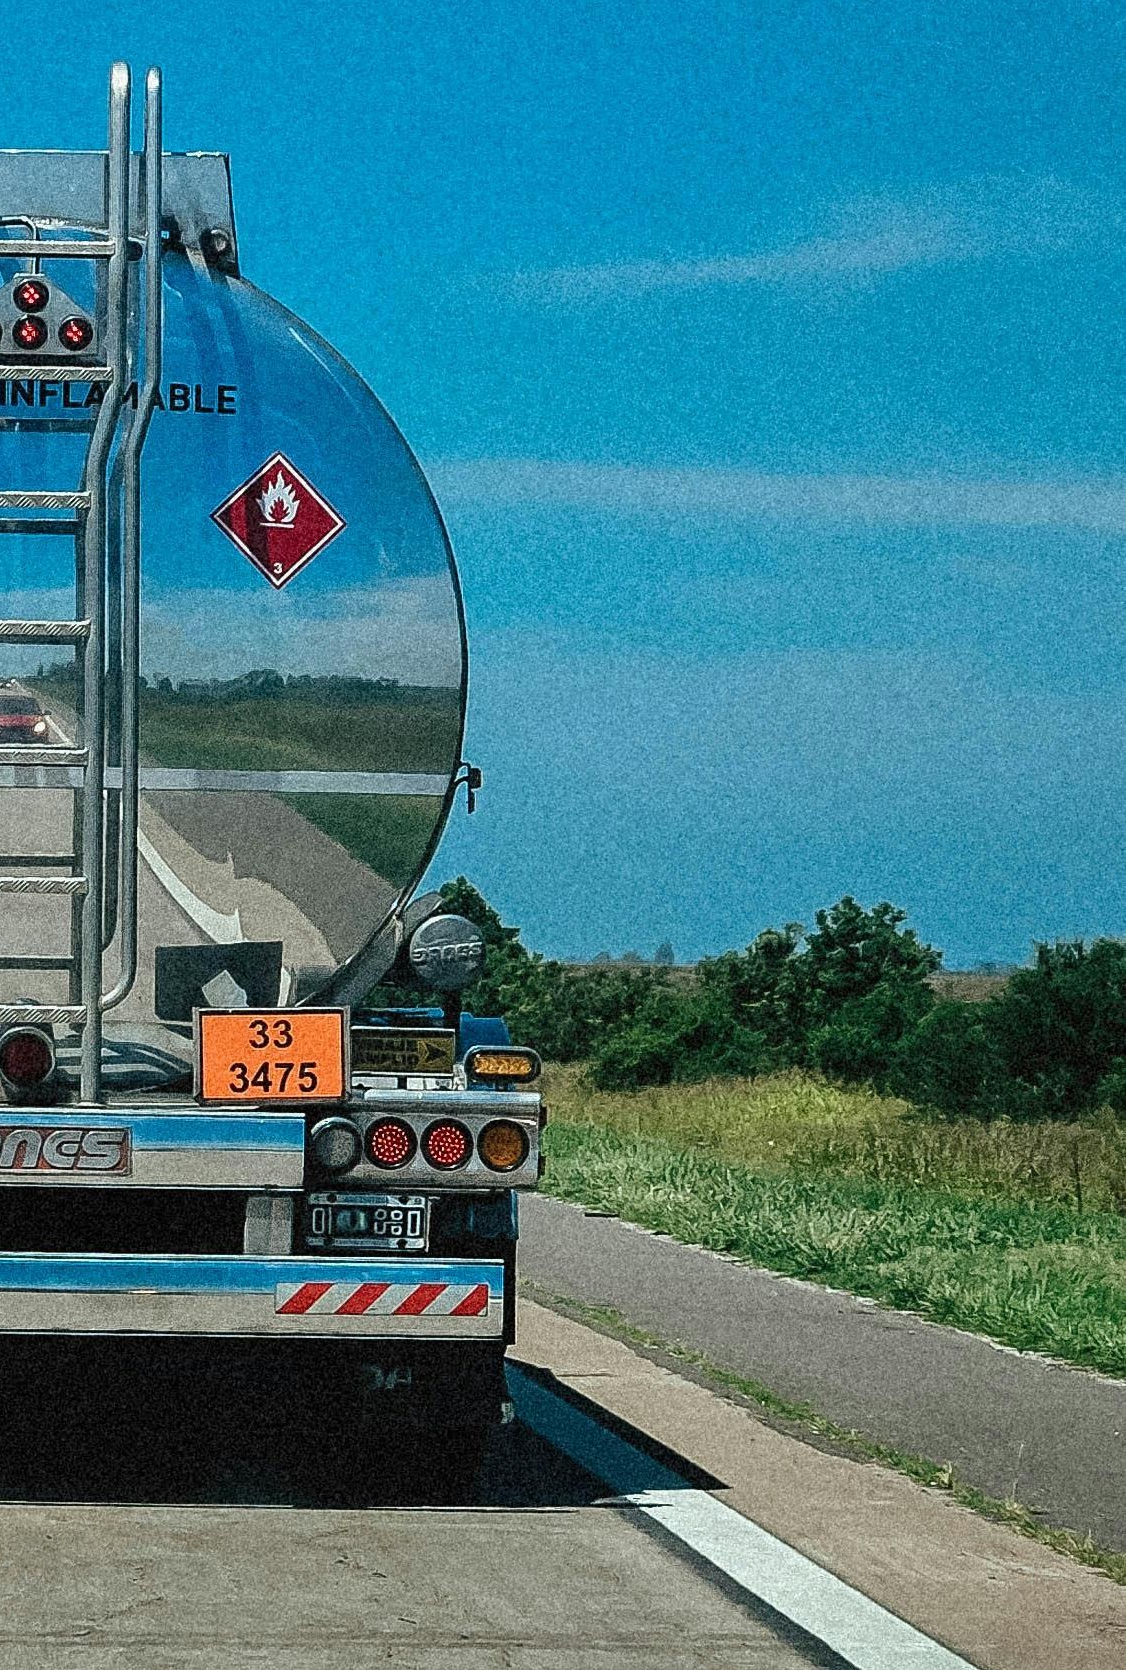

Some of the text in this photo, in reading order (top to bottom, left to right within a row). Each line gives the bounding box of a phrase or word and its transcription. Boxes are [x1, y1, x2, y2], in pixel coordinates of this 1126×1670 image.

[273, 562, 283, 574] 3
[248, 1019, 293, 1049] 33
[229, 1061, 318, 1093] 3475
